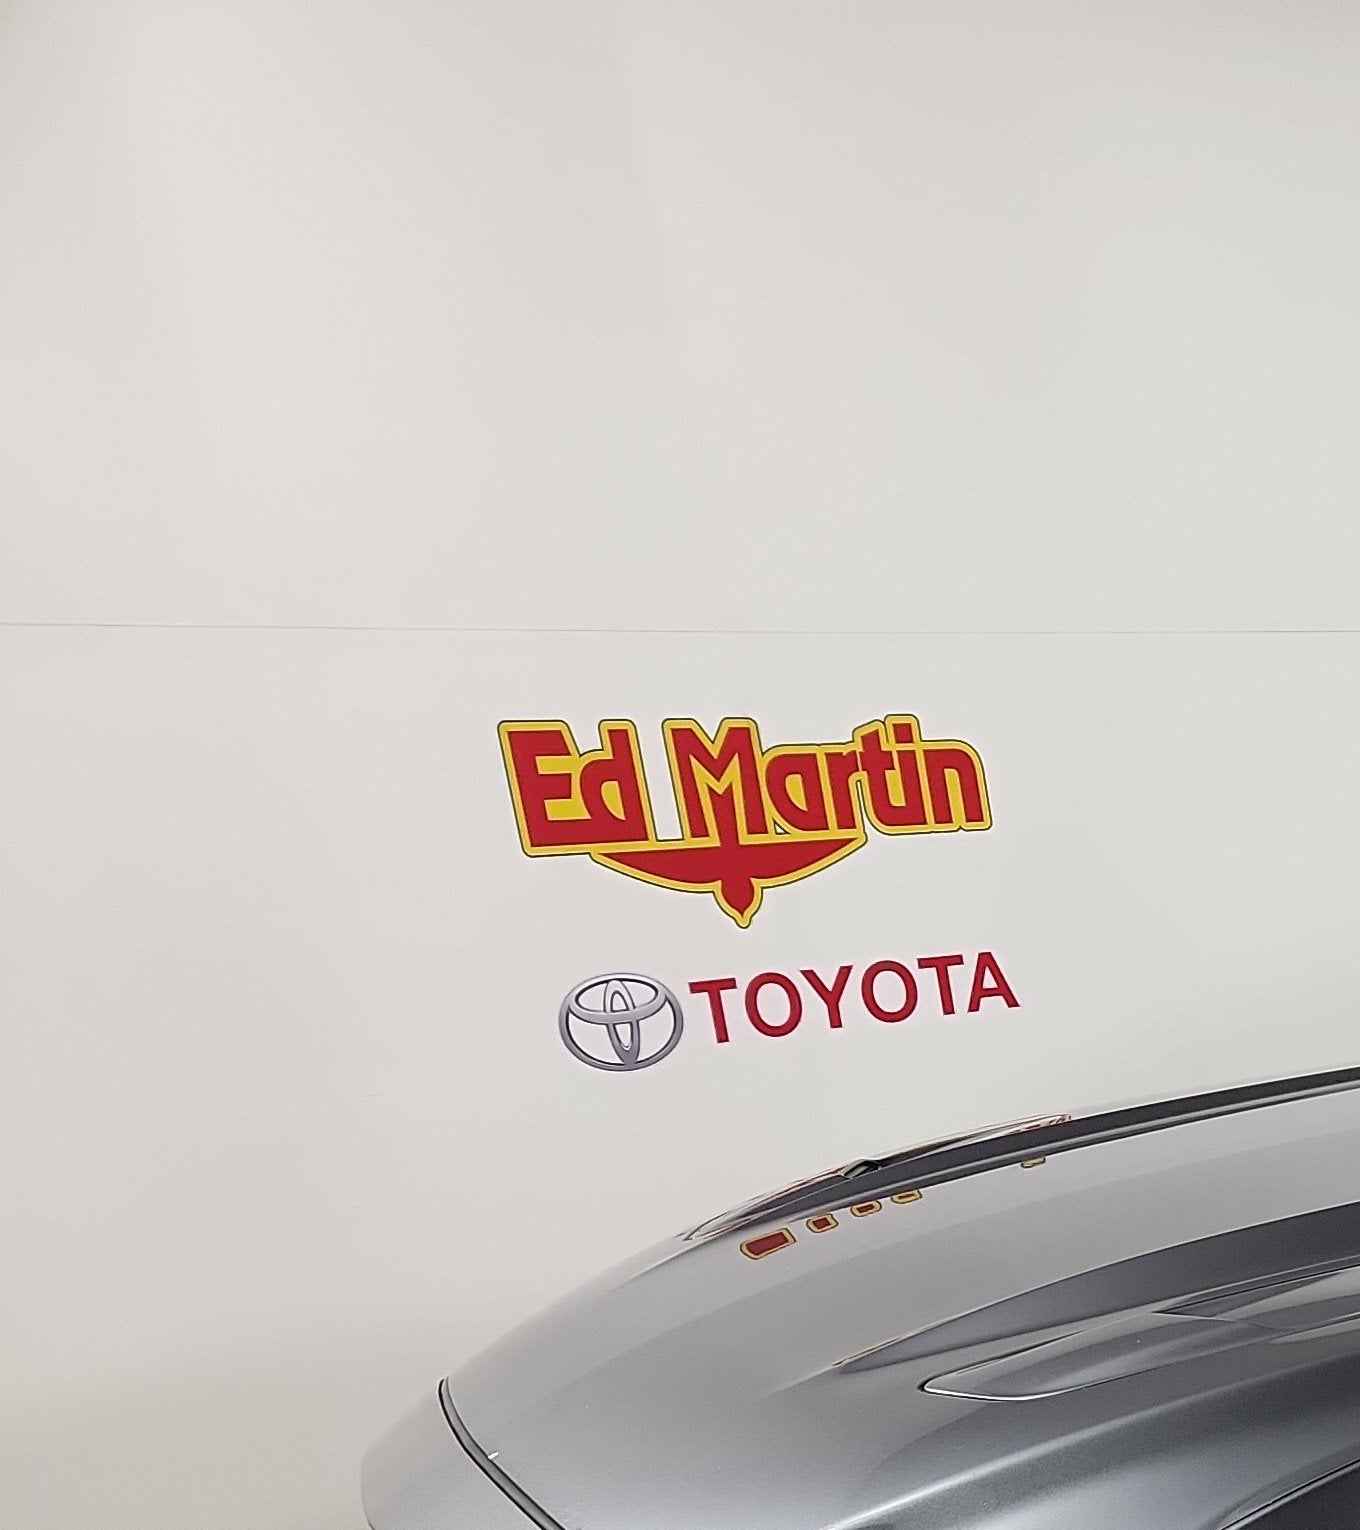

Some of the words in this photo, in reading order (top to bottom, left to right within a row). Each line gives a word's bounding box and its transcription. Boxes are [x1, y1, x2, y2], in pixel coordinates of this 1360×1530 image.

[507, 726, 650, 848] Ed
[671, 721, 987, 838] Martin
[687, 951, 1020, 1045] TOYOTA
